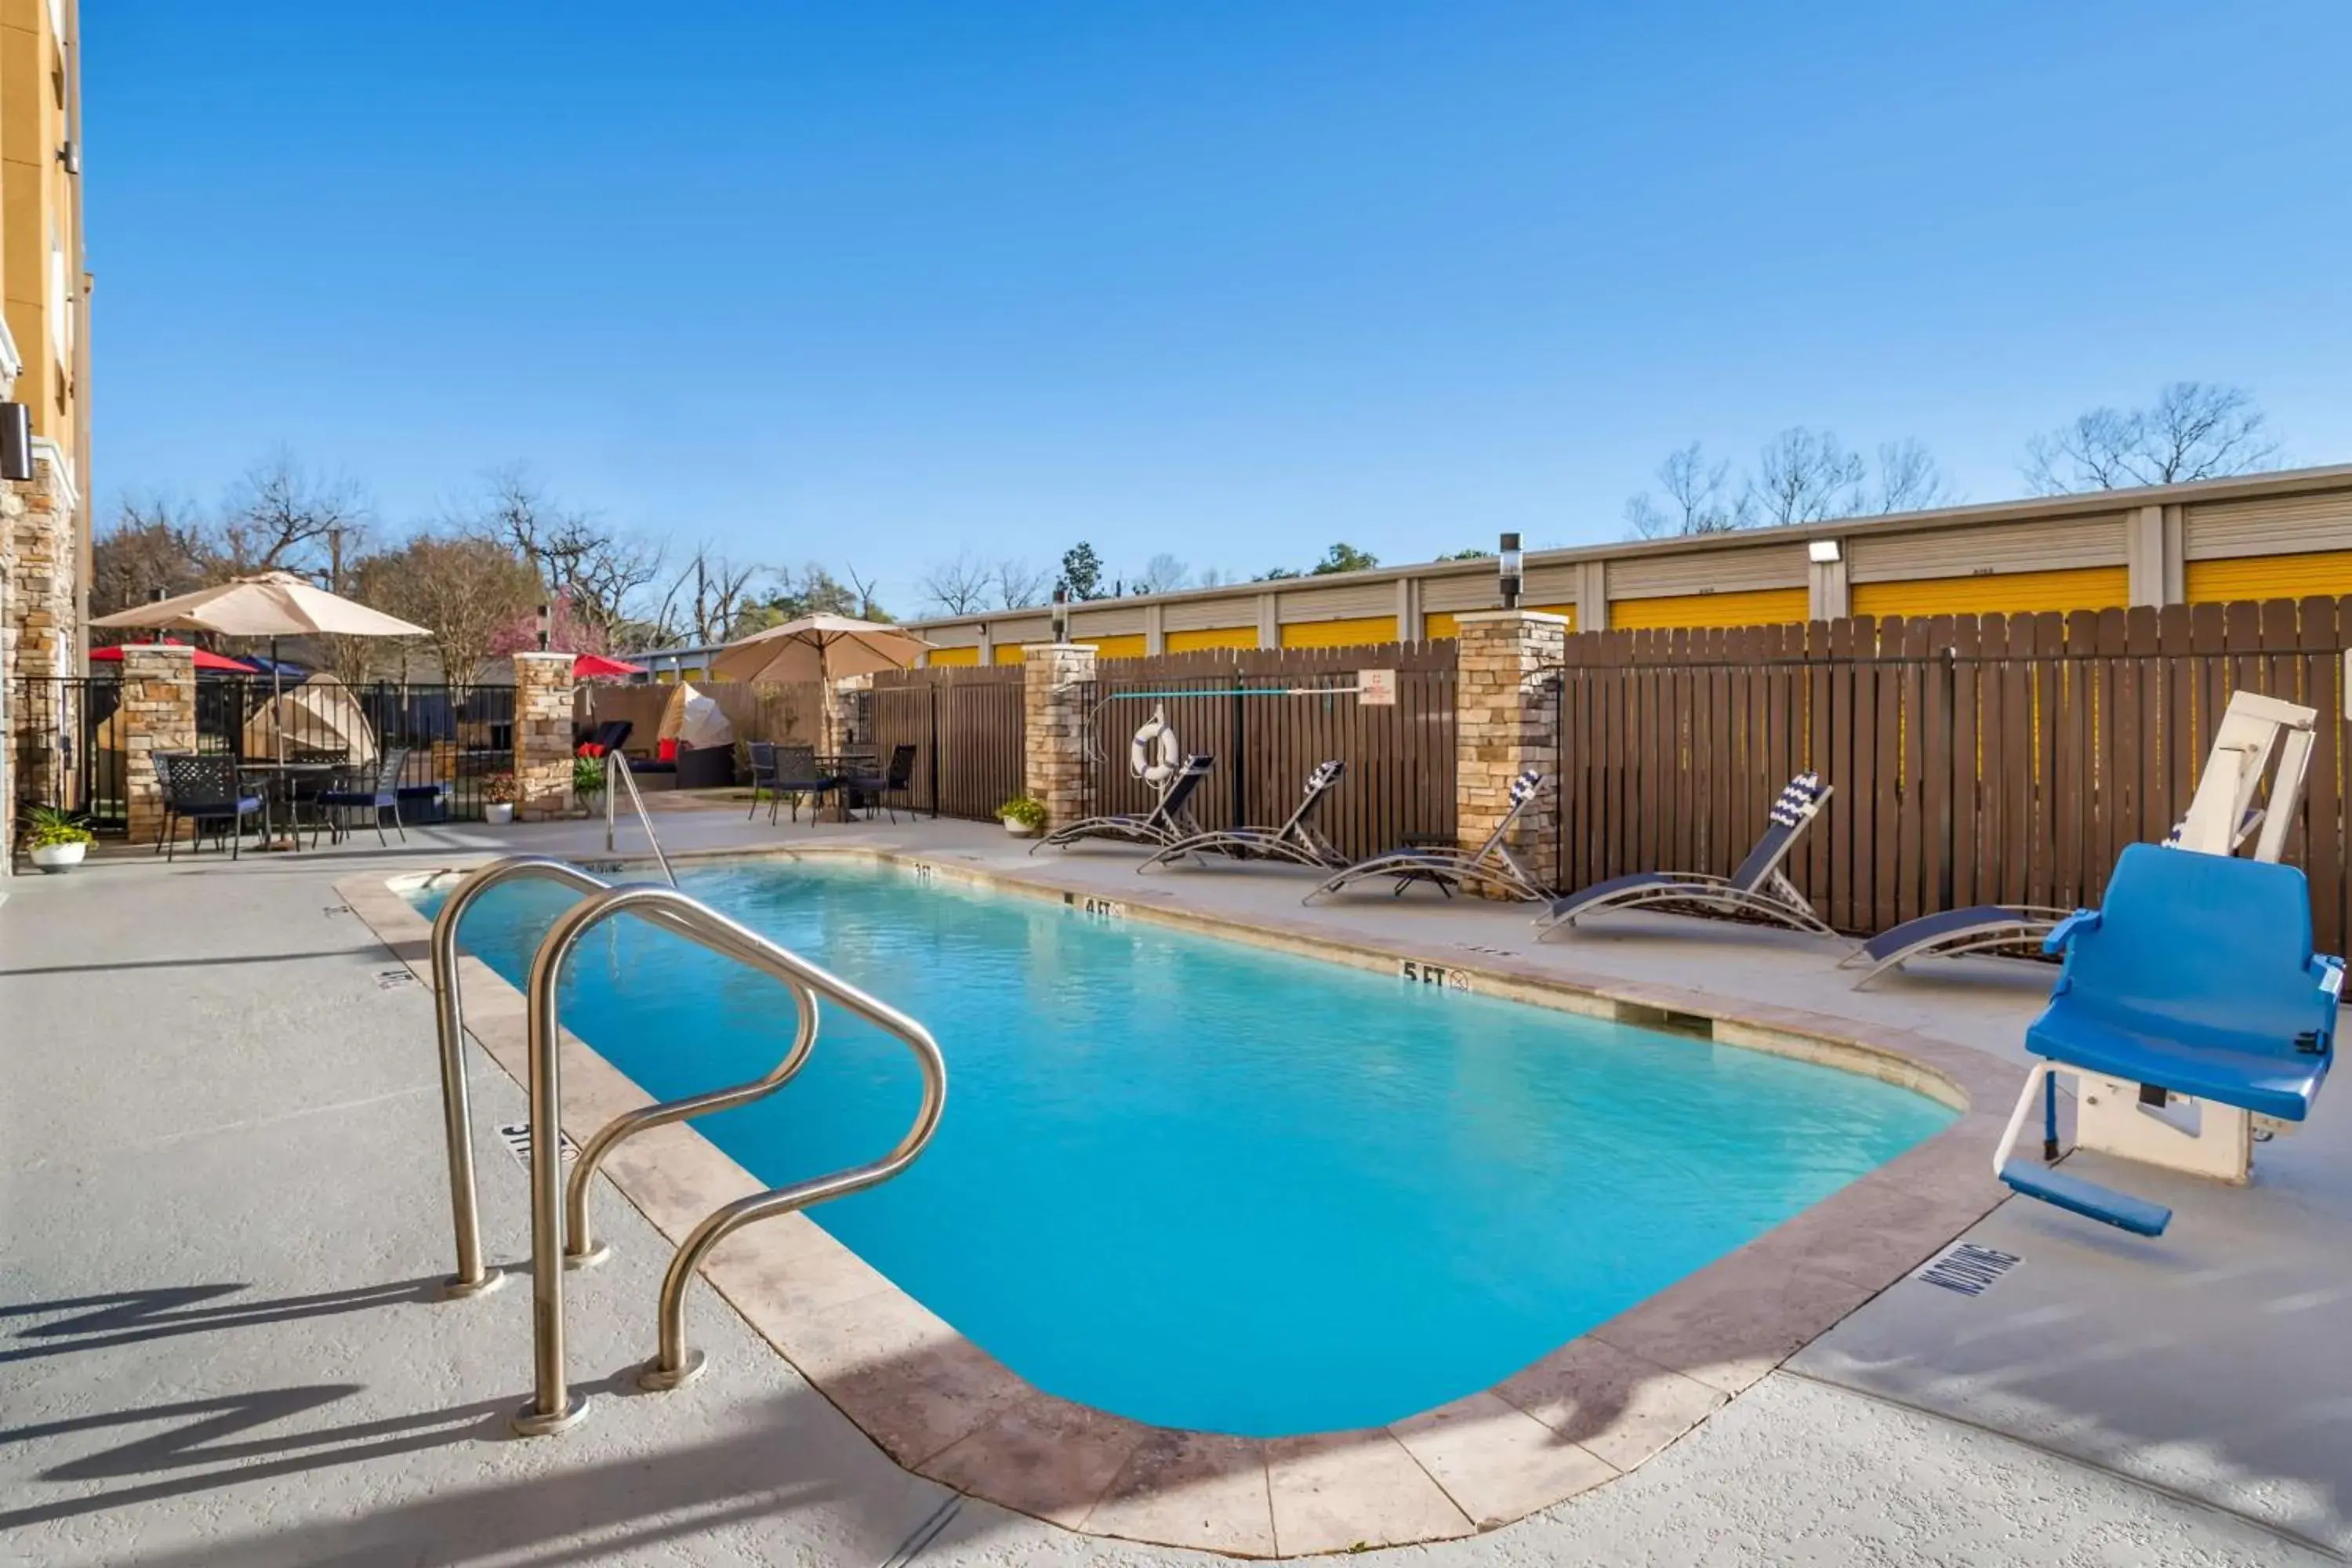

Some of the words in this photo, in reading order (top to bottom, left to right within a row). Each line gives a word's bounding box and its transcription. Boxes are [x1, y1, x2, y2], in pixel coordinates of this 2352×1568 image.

[1086, 898, 1094, 913] 4
[1098, 901, 1111, 915] FT
[1404, 961, 1417, 982] 5
[1423, 965, 1445, 987] FT
